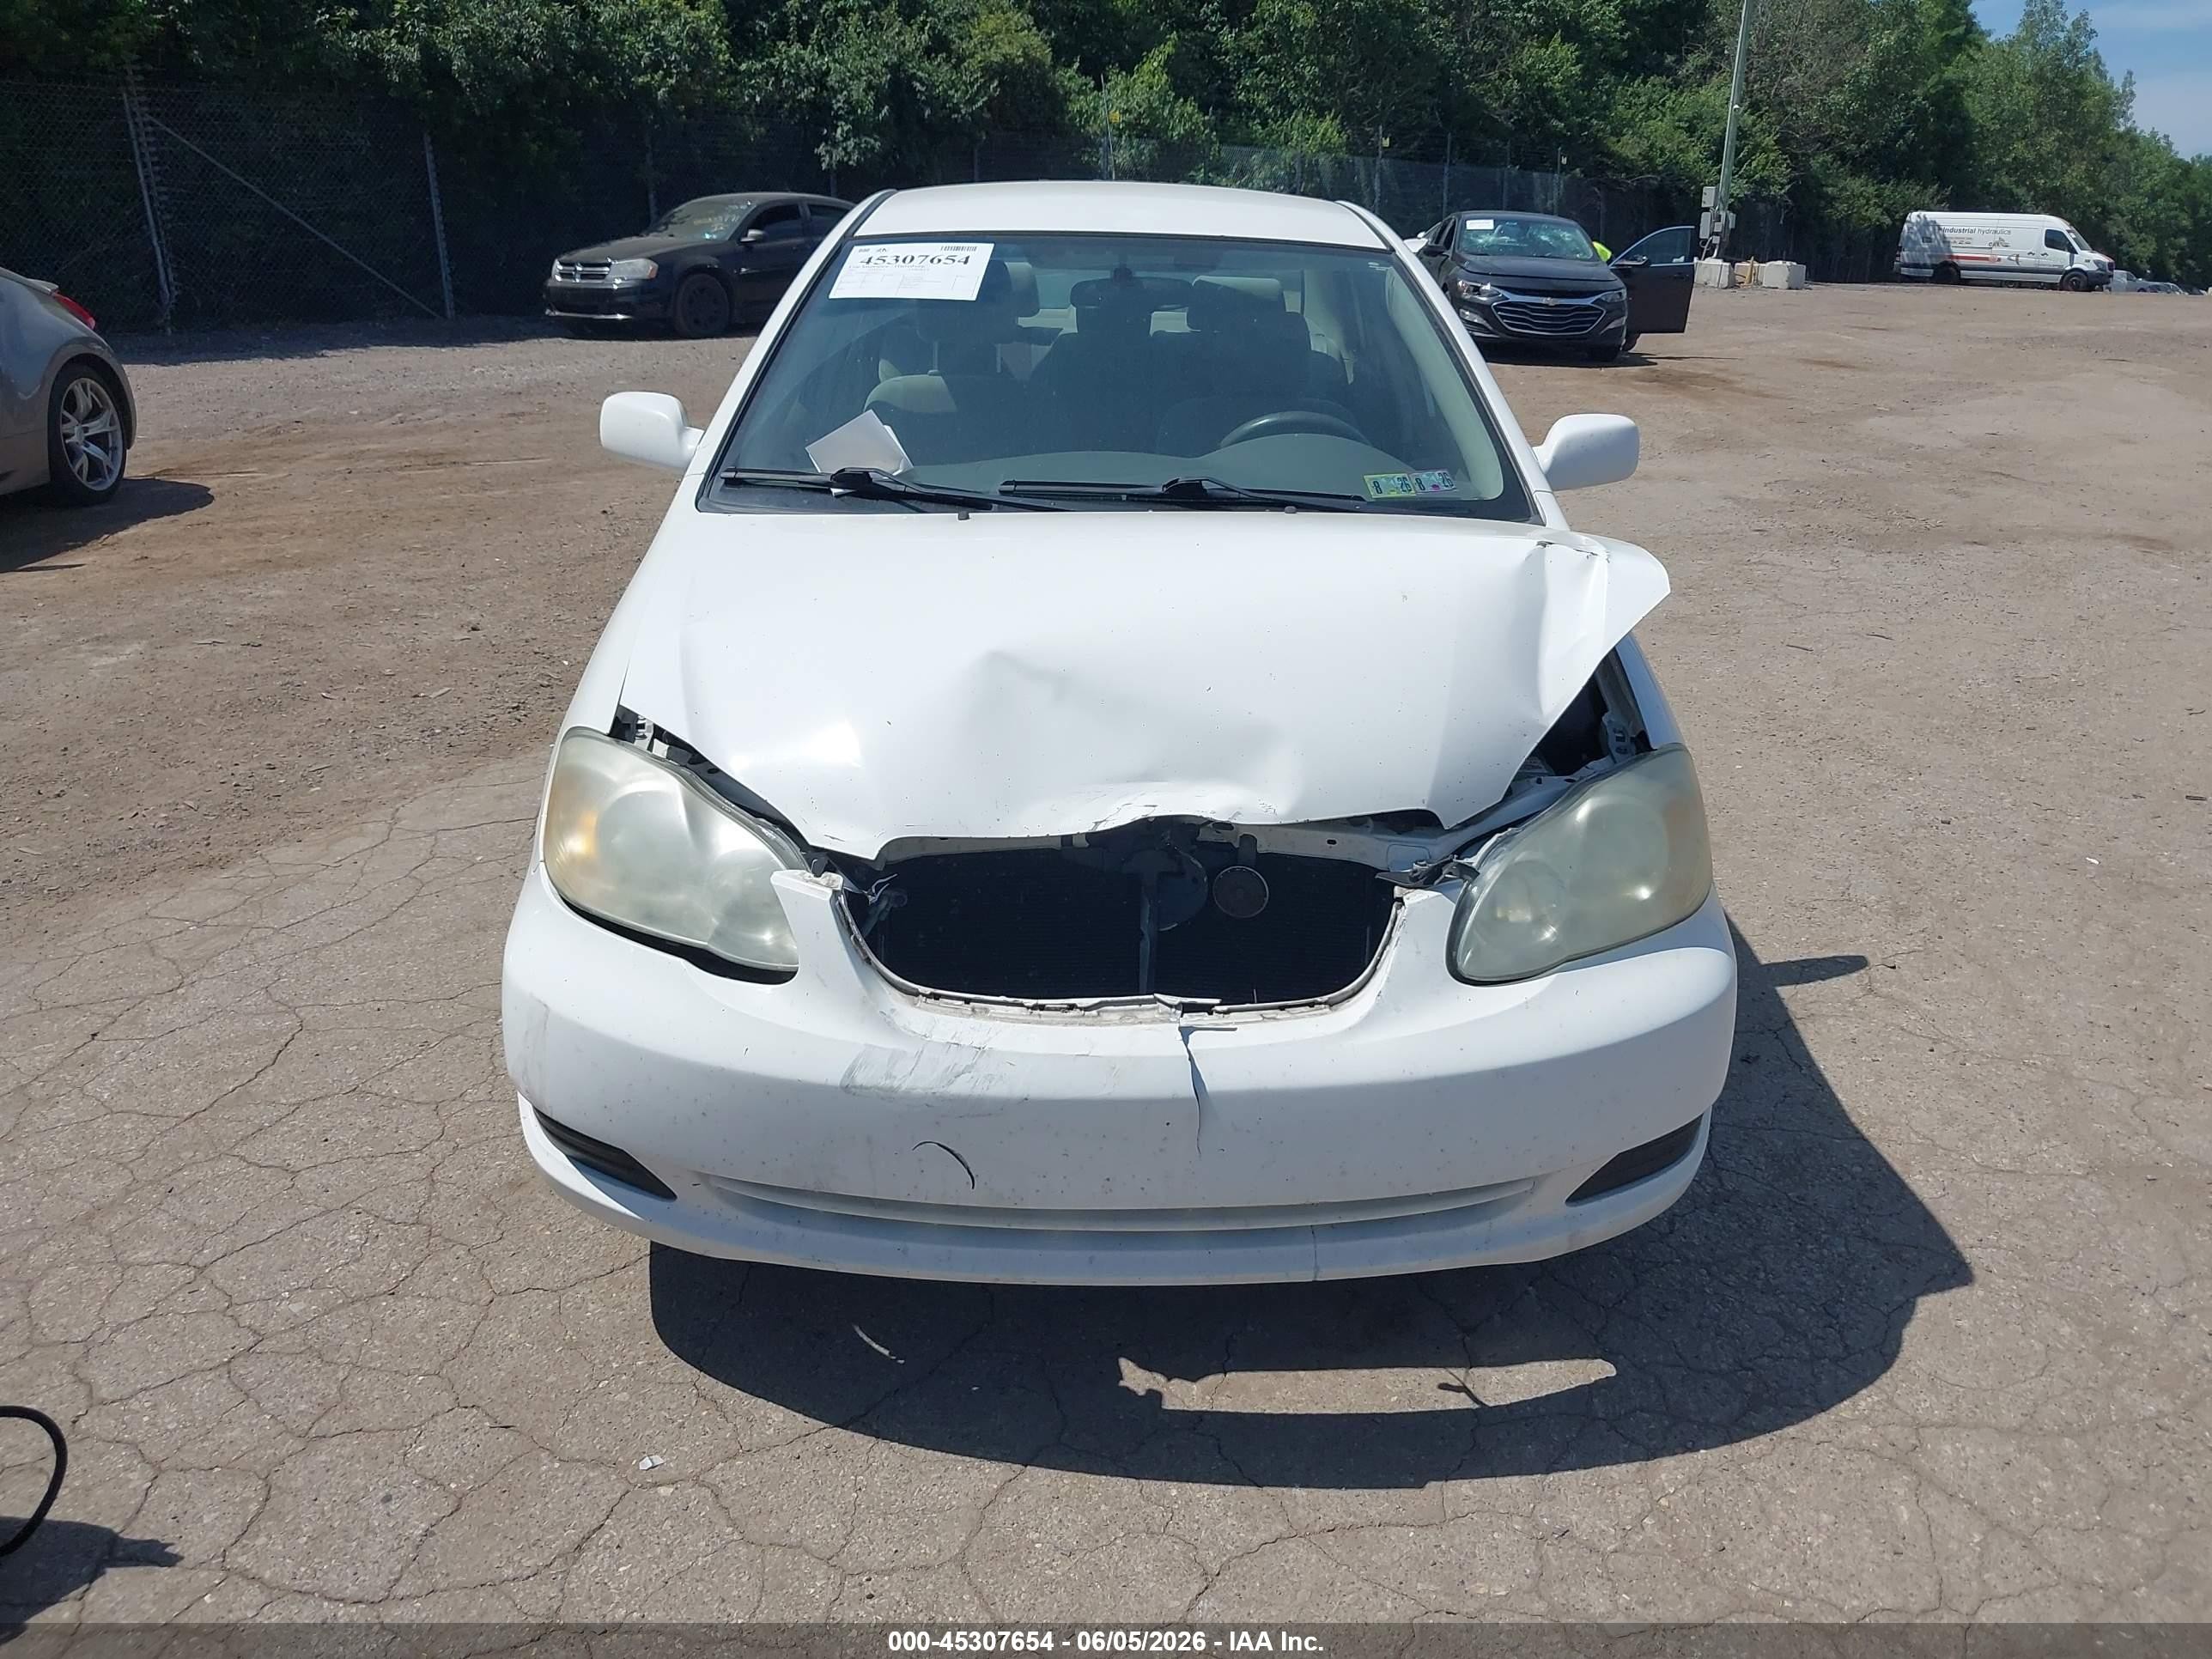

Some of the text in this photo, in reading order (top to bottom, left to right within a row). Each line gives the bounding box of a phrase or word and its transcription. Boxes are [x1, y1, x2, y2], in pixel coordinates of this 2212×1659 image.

[1978, 228, 2011, 236] hydraulics
[859, 254, 970, 265] 45307654
[1373, 477, 1412, 494] 8 26
[1437, 472, 1454, 488] 26
